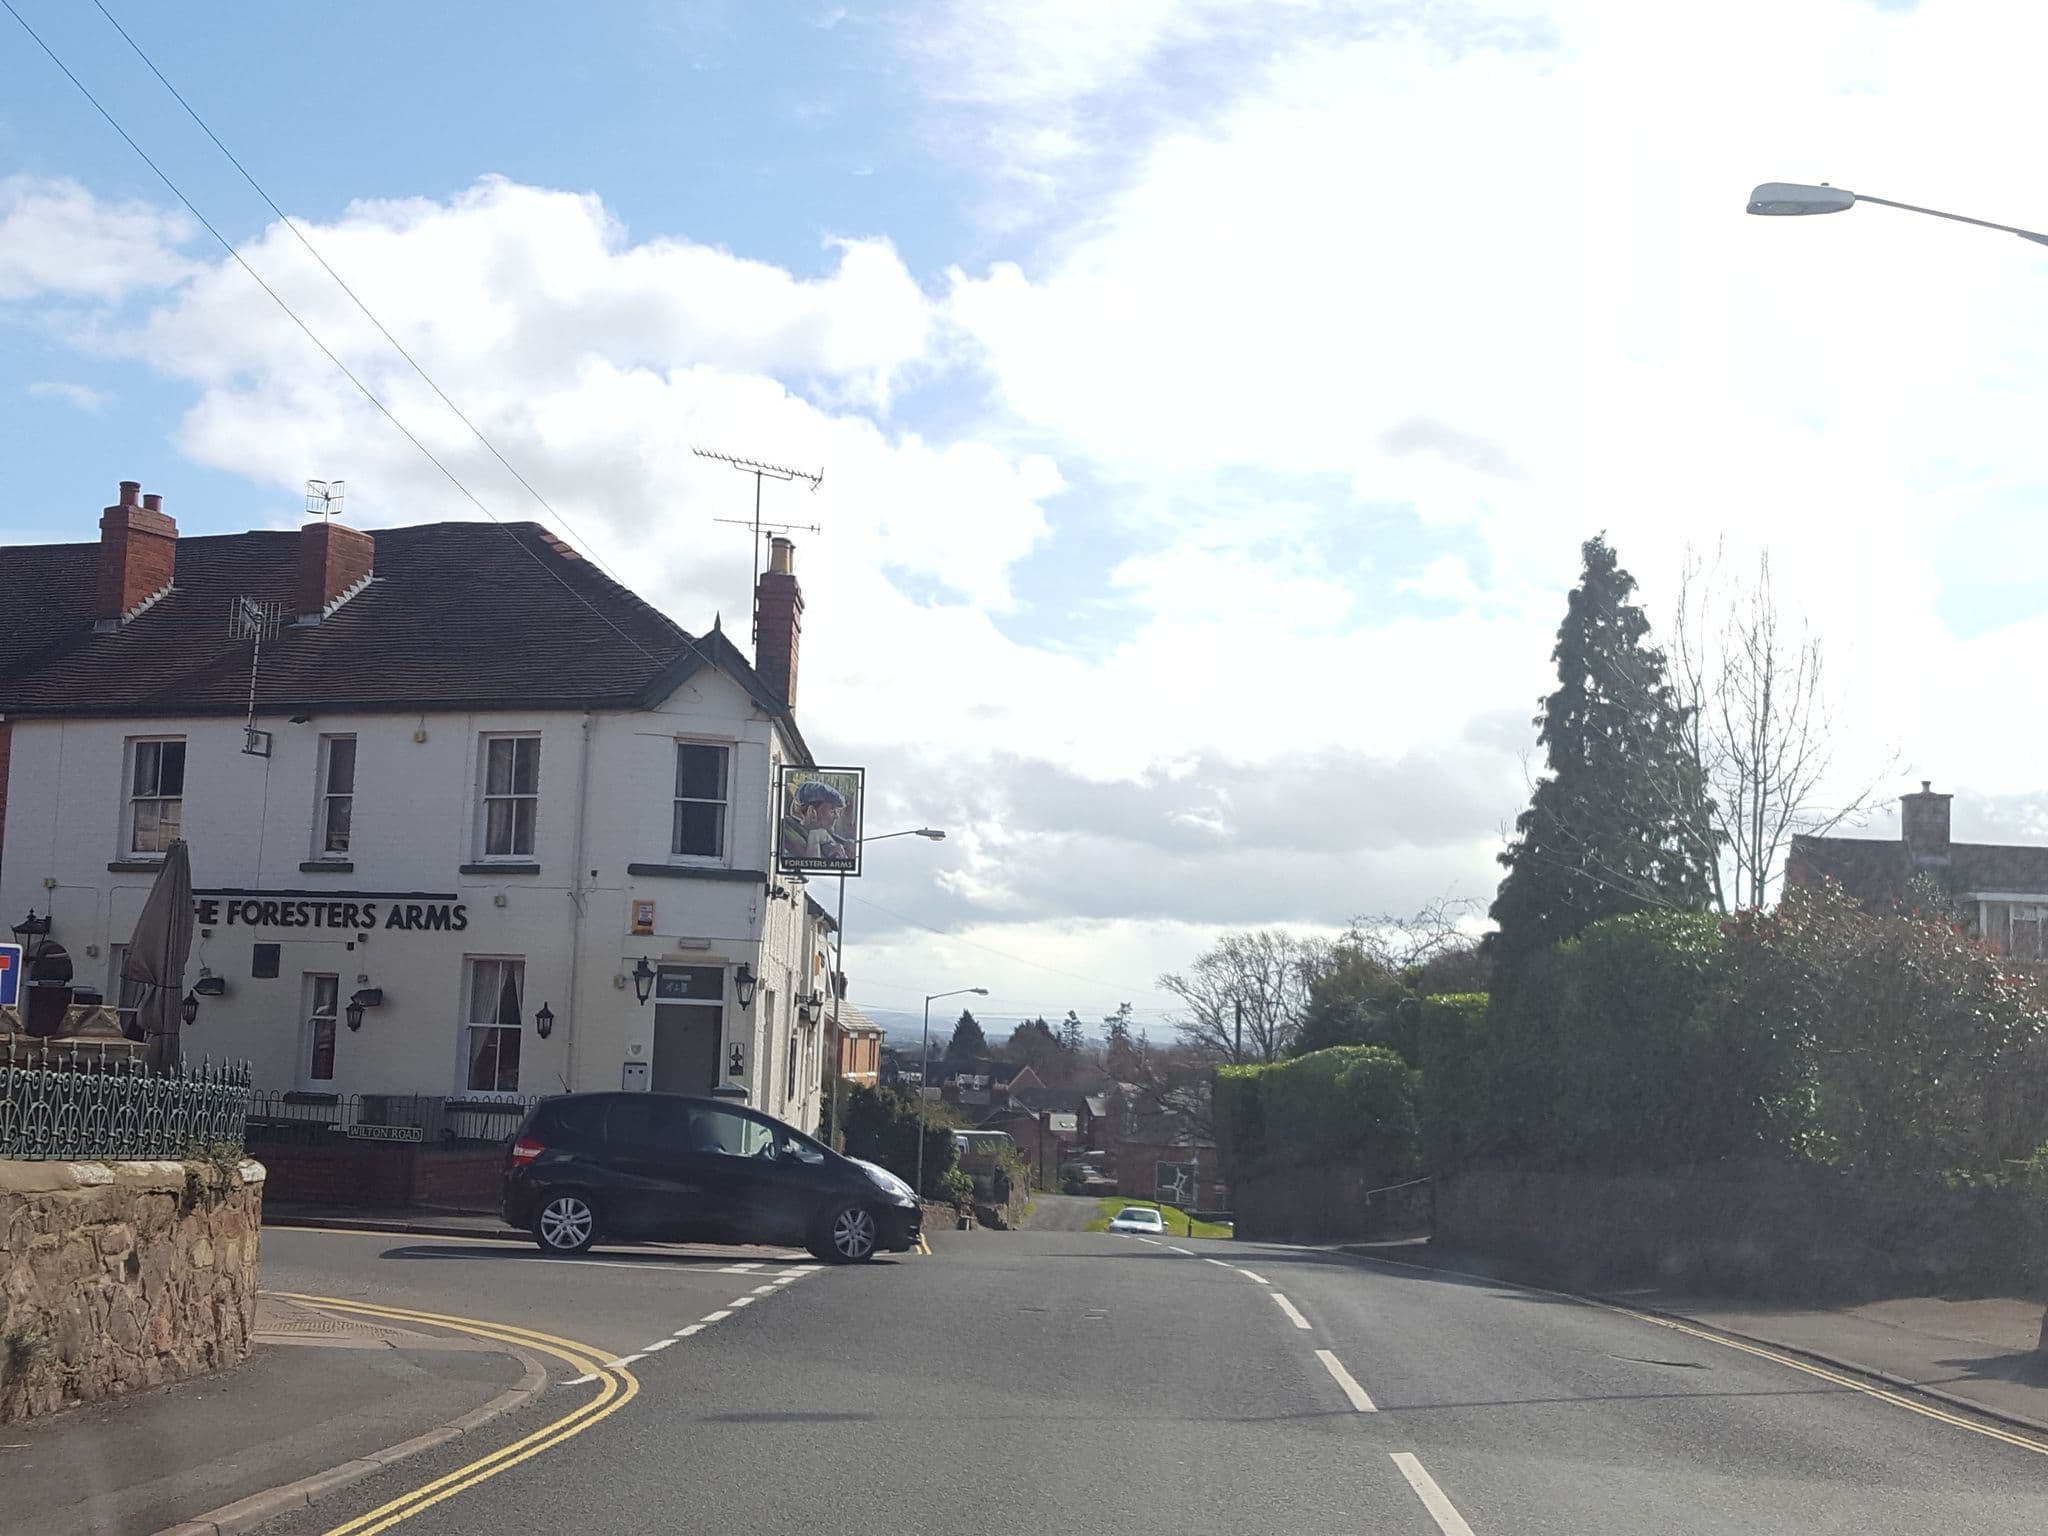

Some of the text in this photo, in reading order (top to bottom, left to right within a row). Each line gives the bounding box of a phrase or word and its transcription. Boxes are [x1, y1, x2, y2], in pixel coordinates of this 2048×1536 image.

[784, 859, 853, 869] FORESTERS ARMS
[192, 899, 468, 931] HE FORESTERS ARMS
[350, 1126, 420, 1140] WILTON ROAD
